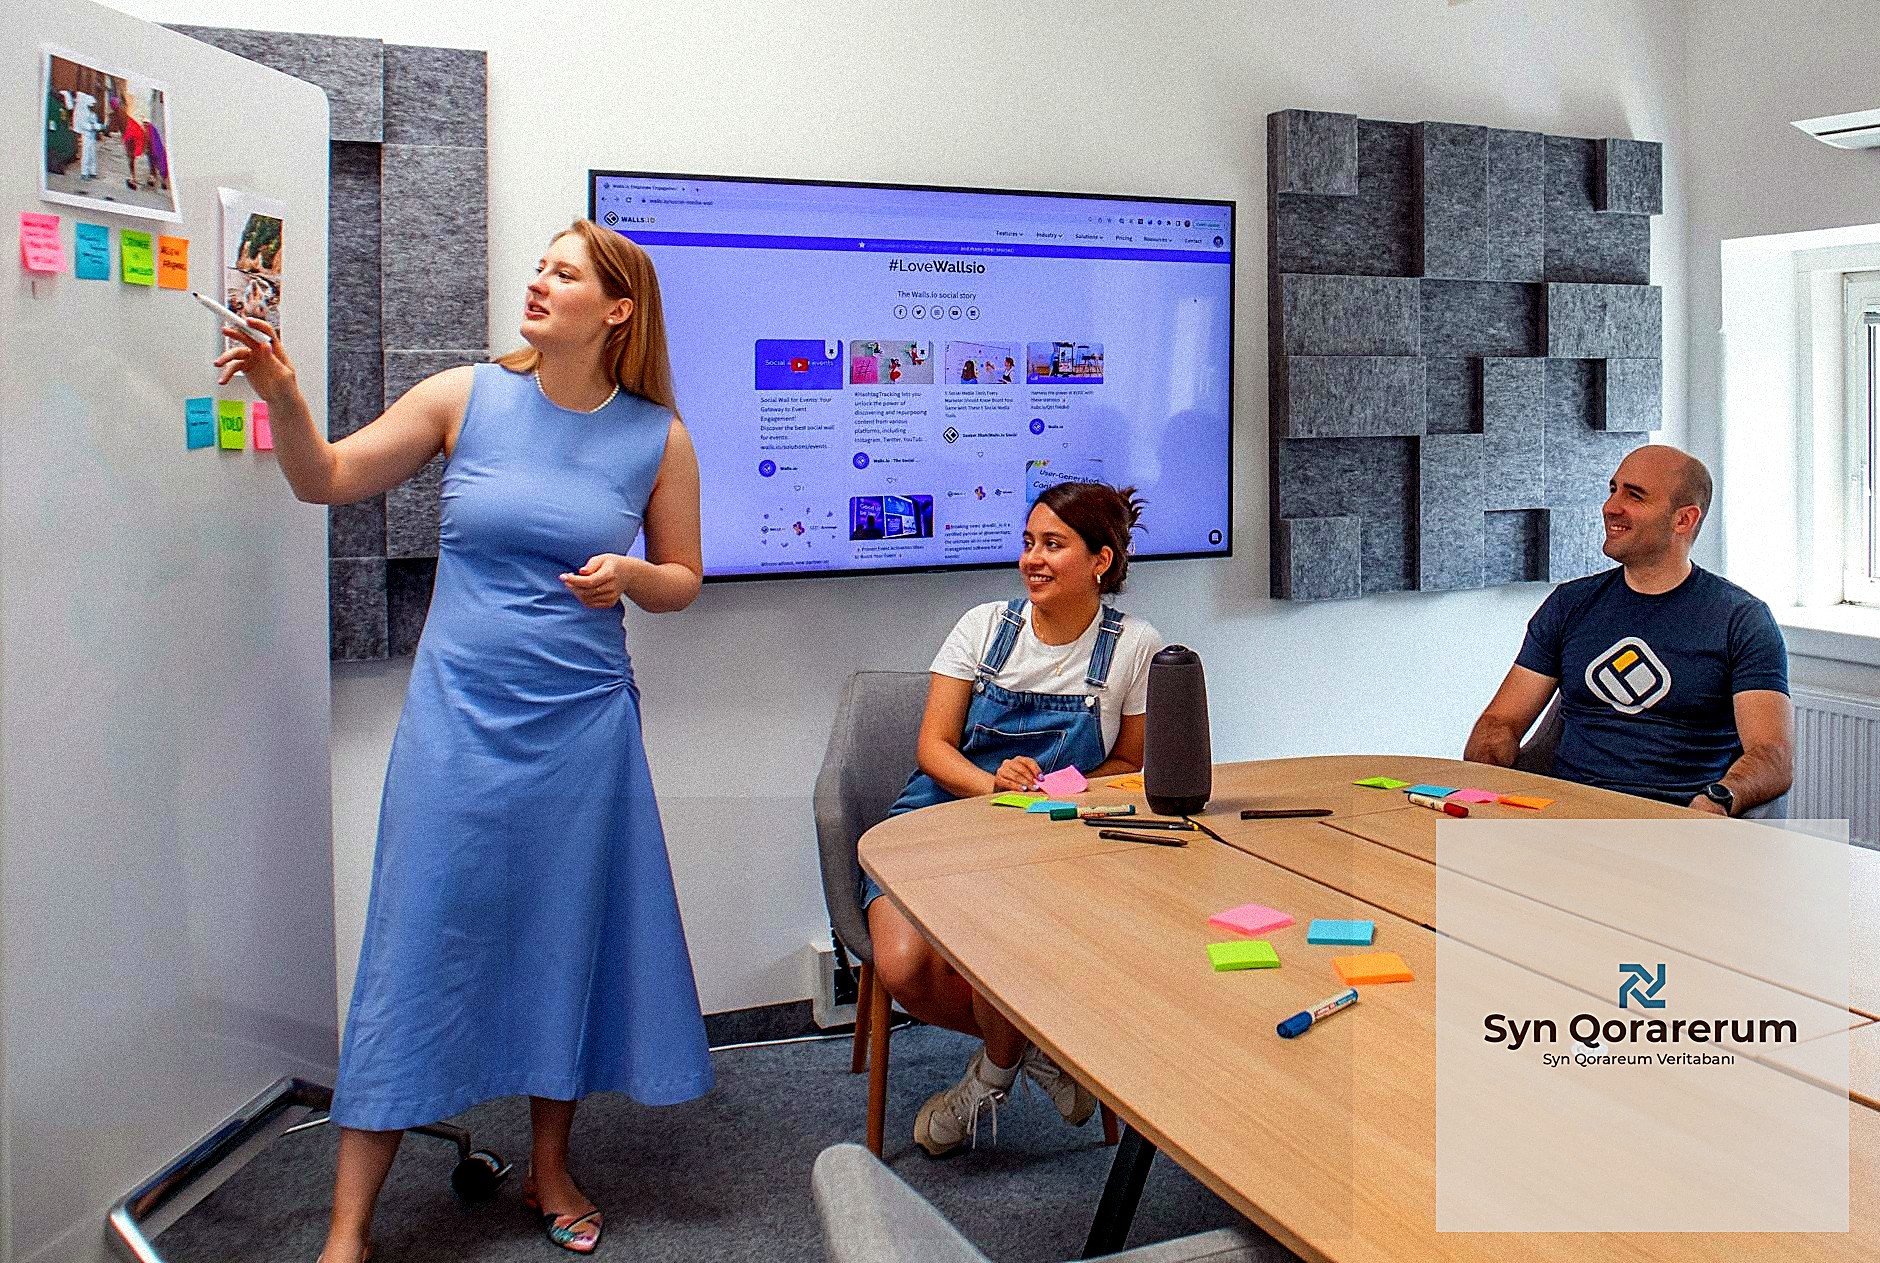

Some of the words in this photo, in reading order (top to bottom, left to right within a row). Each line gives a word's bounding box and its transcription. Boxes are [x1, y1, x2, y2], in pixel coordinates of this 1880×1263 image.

[1036, 231, 1057, 239] Industry
[889, 259, 986, 274] #LoveWallsio
[911, 291, 937, 299] Walls.io
[960, 293, 977, 301] story
[1040, 469, 1099, 484] User-Generated
